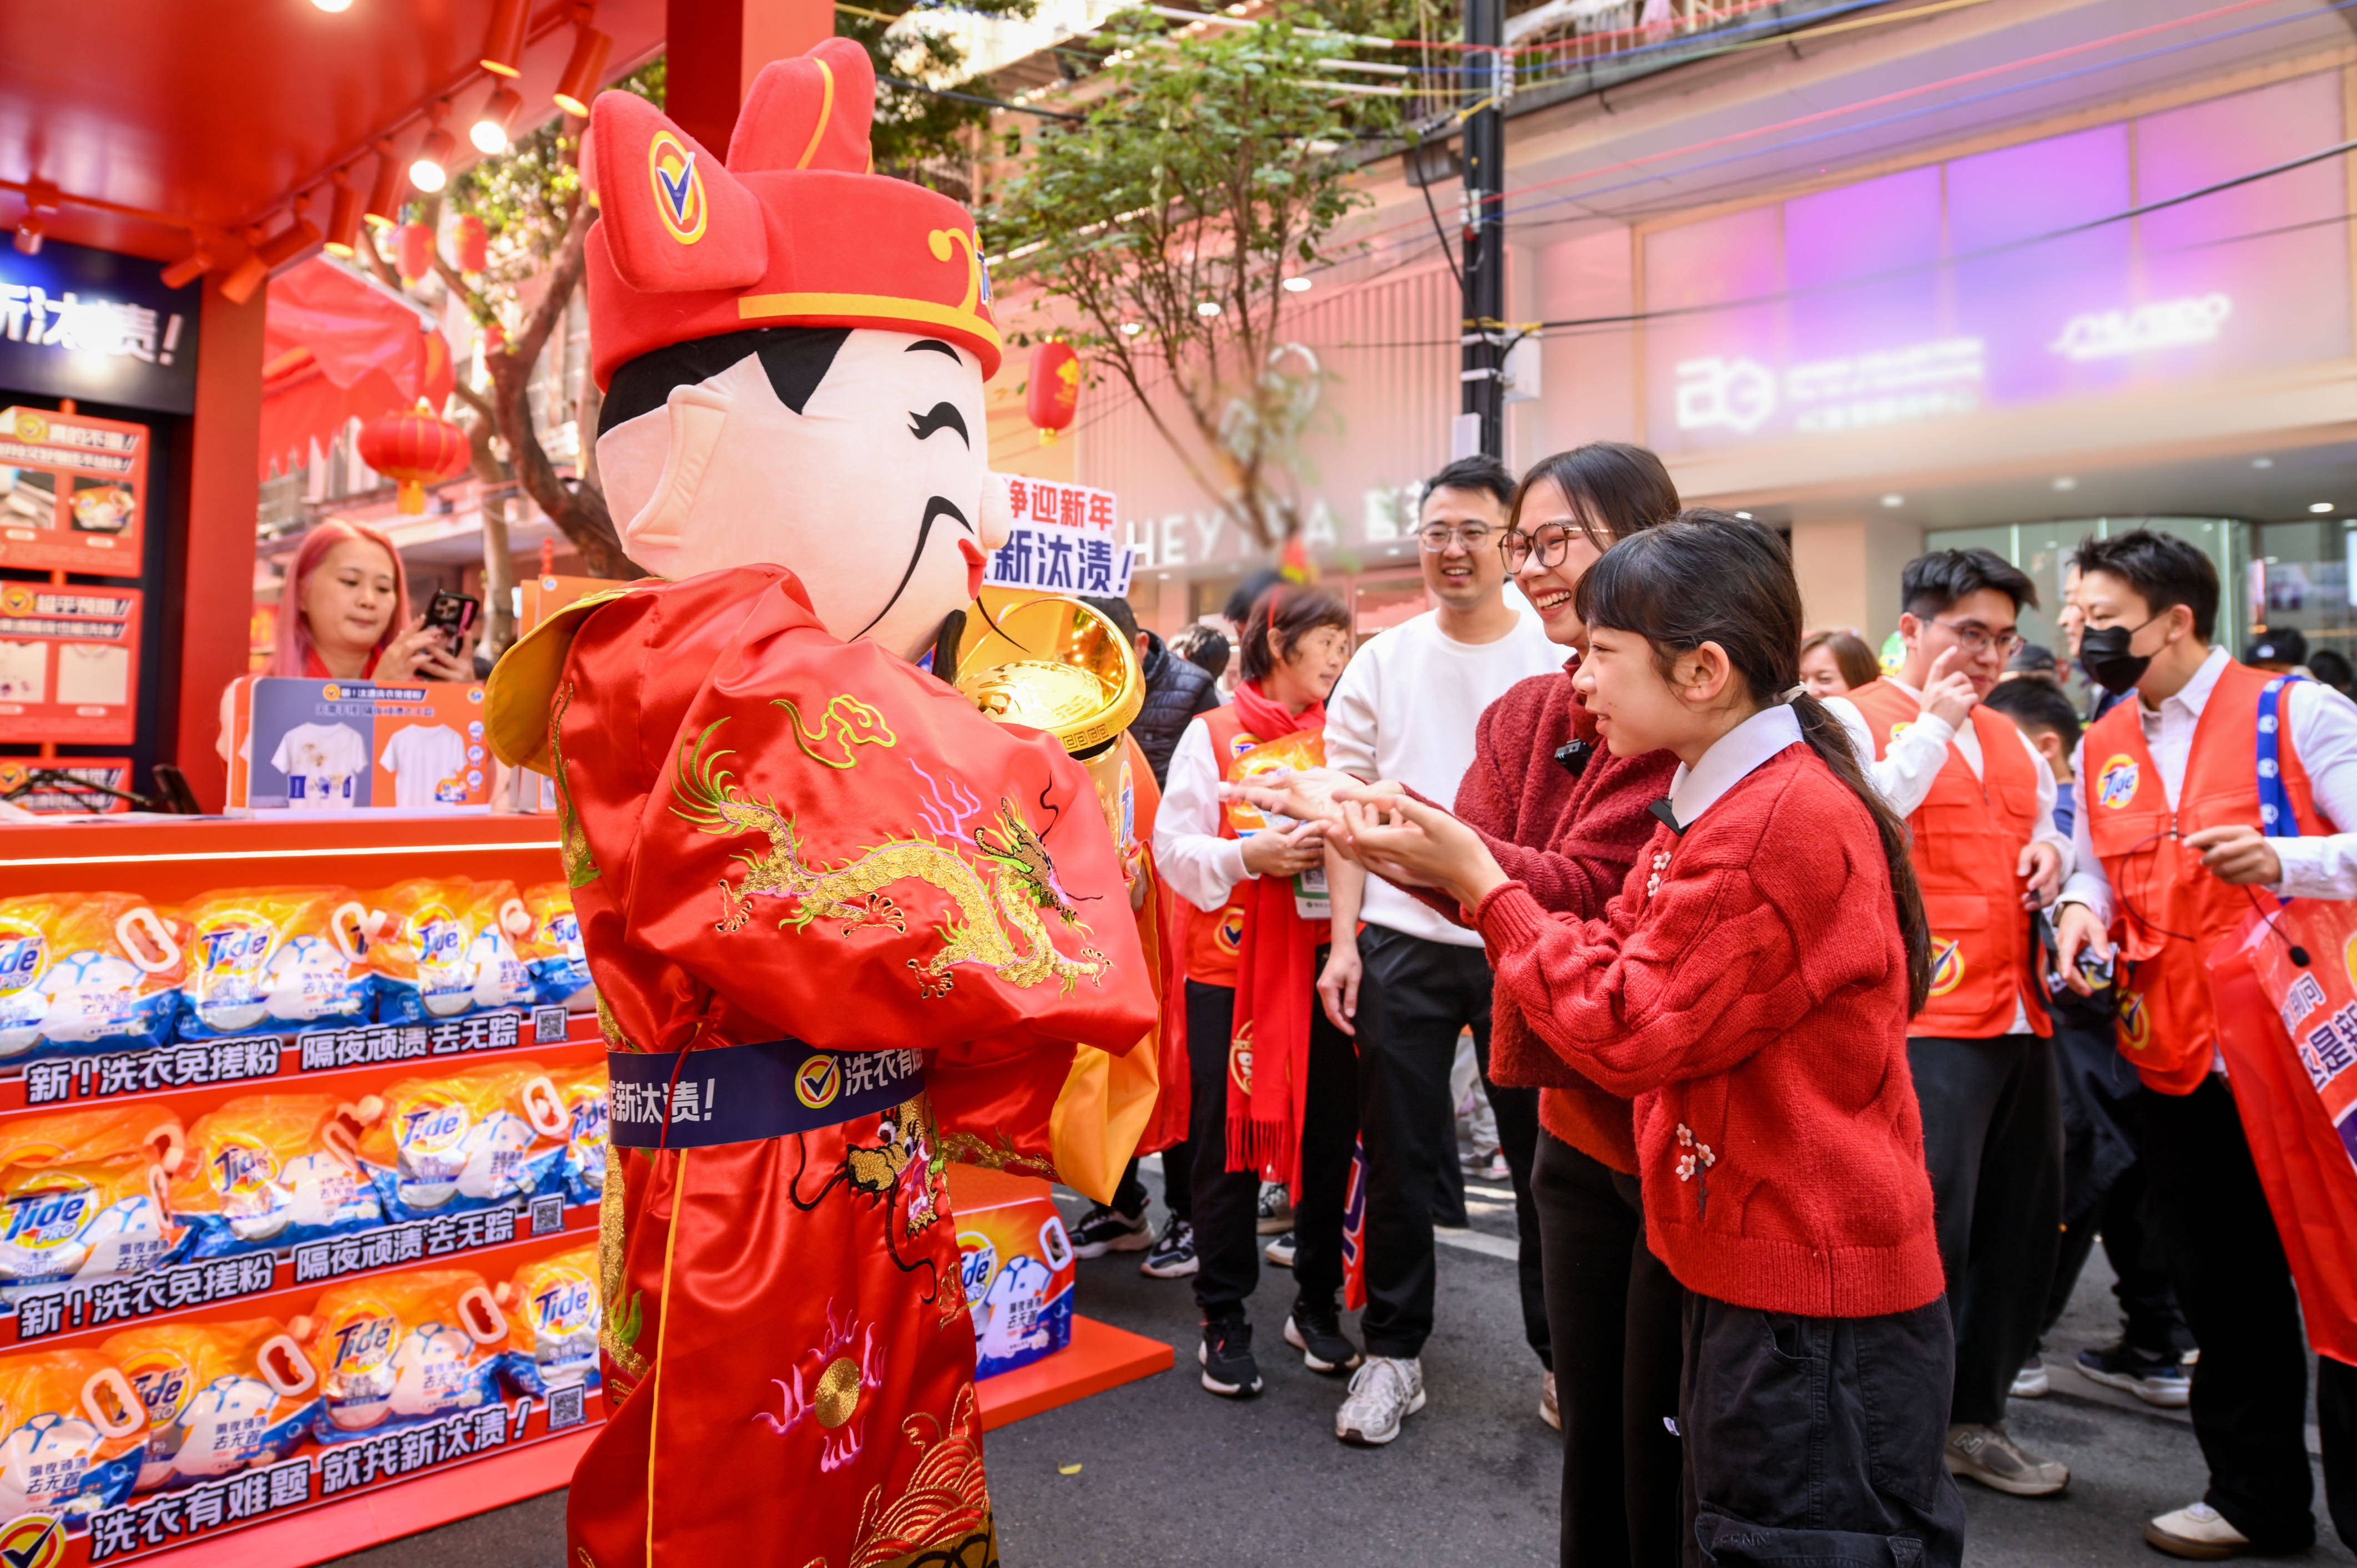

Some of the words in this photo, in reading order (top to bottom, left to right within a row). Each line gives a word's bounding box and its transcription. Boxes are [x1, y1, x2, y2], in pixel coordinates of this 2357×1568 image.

[985, 530, 1132, 592] 新汰渍！
[0, 940, 38, 974] de
[201, 931, 268, 971] Tide
[0, 973, 33, 990] PRO
[29, 1039, 277, 1102] 新！洗衣免搓粉
[302, 1015, 518, 1070] 隔夜顽渍去无踪
[403, 1110, 459, 1148] Tide
[6, 1192, 85, 1241] Tide
[35, 1222, 78, 1244] PRO
[21, 1256, 273, 1337] 新！洗衣免搓粉
[297, 1211, 514, 1282] 隔夜顽渍去无踪
[962, 1254, 990, 1288] de
[534, 1287, 589, 1329] Tide
[334, 1321, 390, 1369] Tide
[93, 1463, 310, 1559] 洗衣有难题
[324, 1402, 531, 1494] 就找新汰渍！
